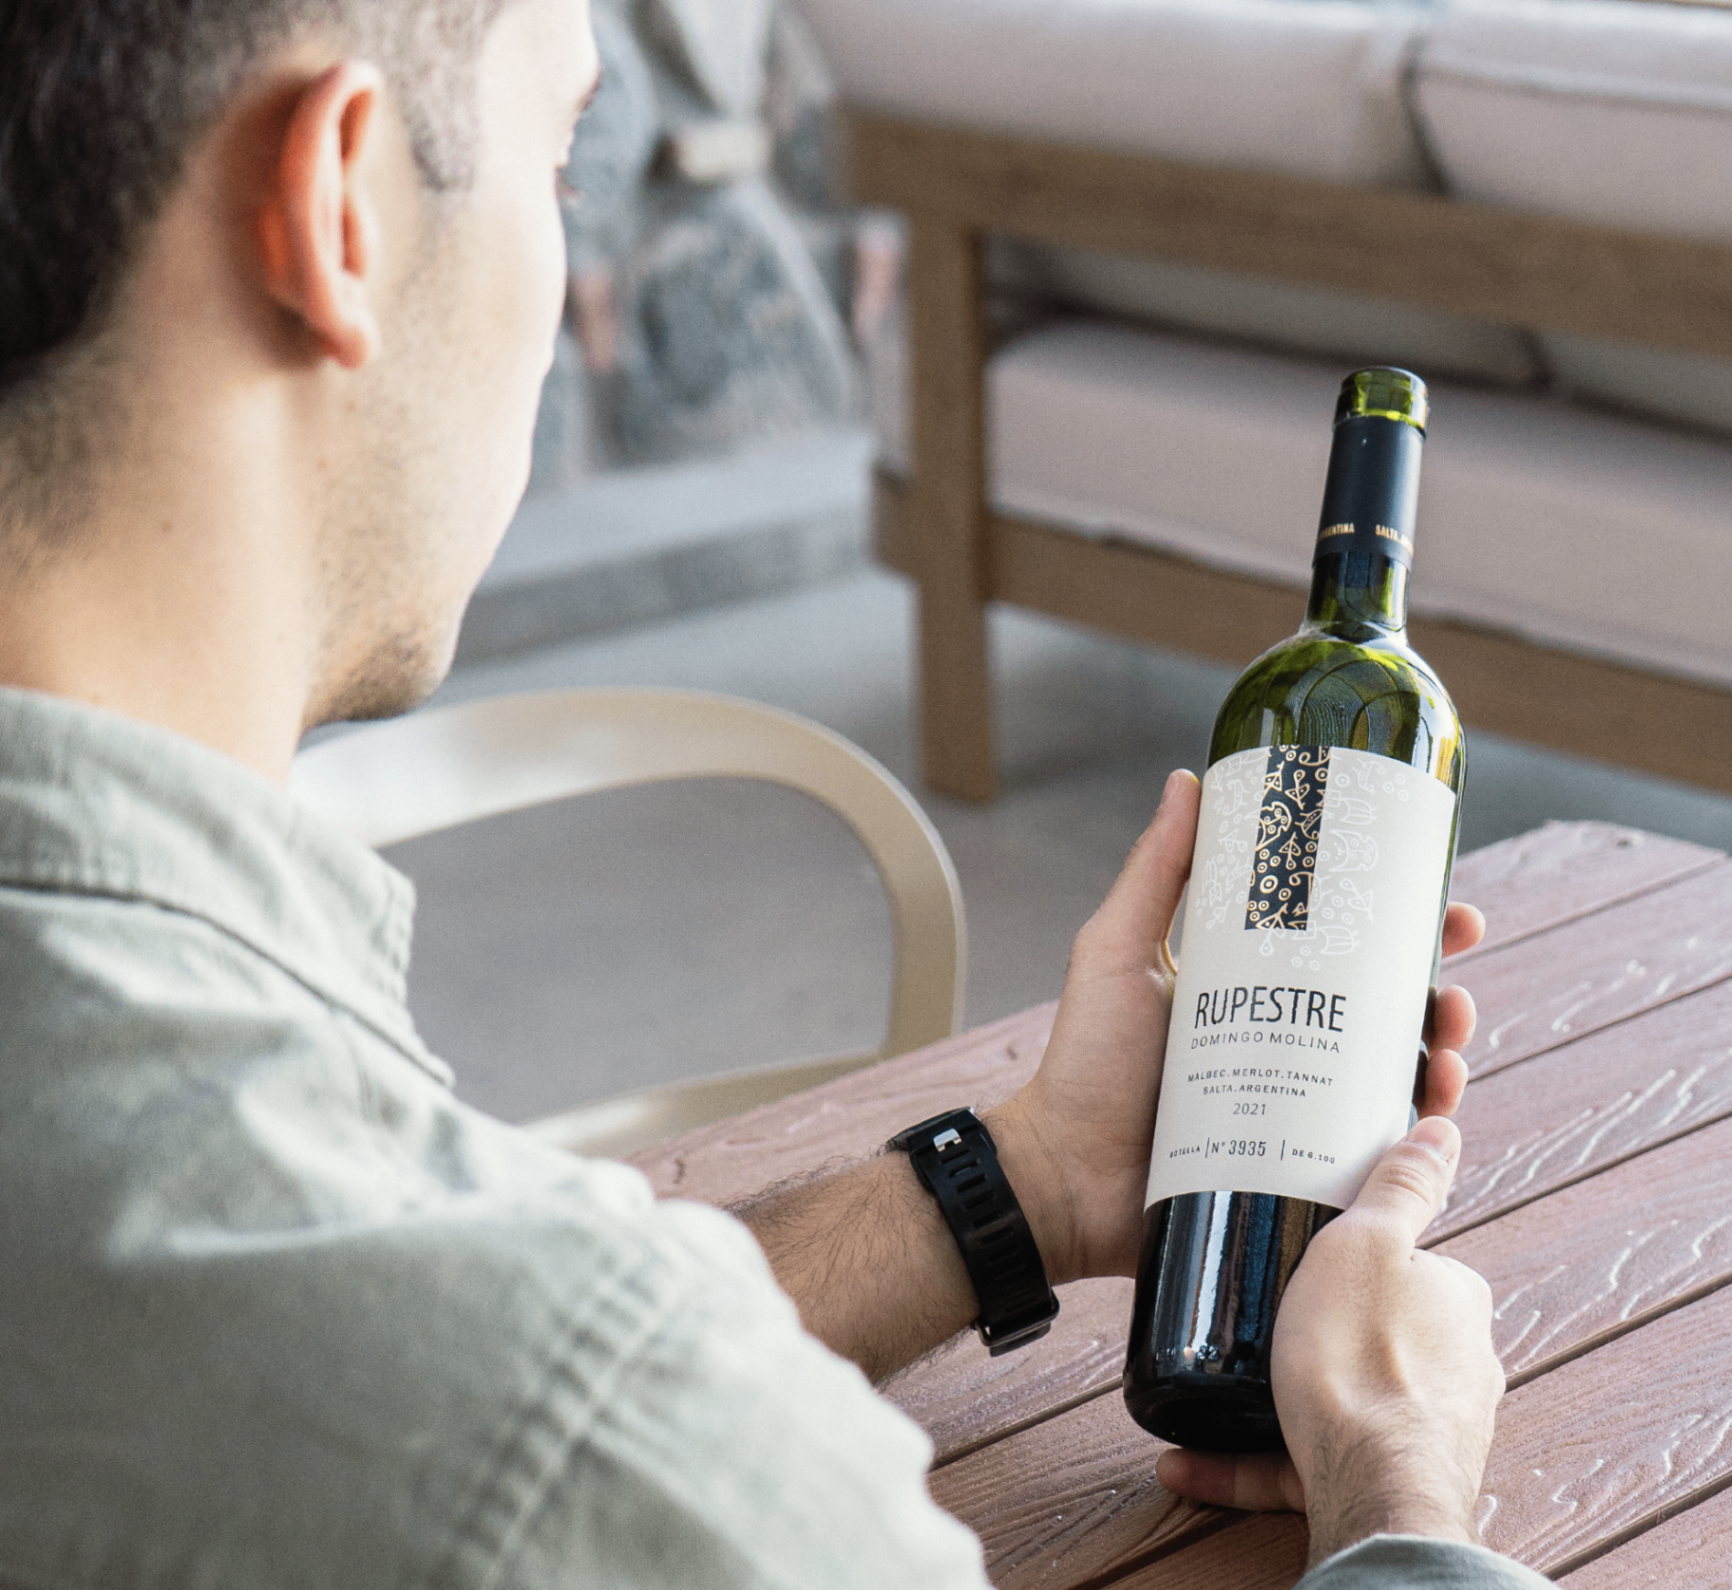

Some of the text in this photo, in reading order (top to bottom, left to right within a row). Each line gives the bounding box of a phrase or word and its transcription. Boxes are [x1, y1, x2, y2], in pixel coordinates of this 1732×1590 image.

[1194, 985, 1347, 1033] RUPESTRE
[1191, 1031, 1340, 1053] DOMINGO MOLINA
[1232, 1102, 1267, 1116] 2021
[1169, 1145, 1200, 1158] BOTELLA
[1228, 1139, 1267, 1157] 3935
[1291, 1148, 1305, 1158] DE
